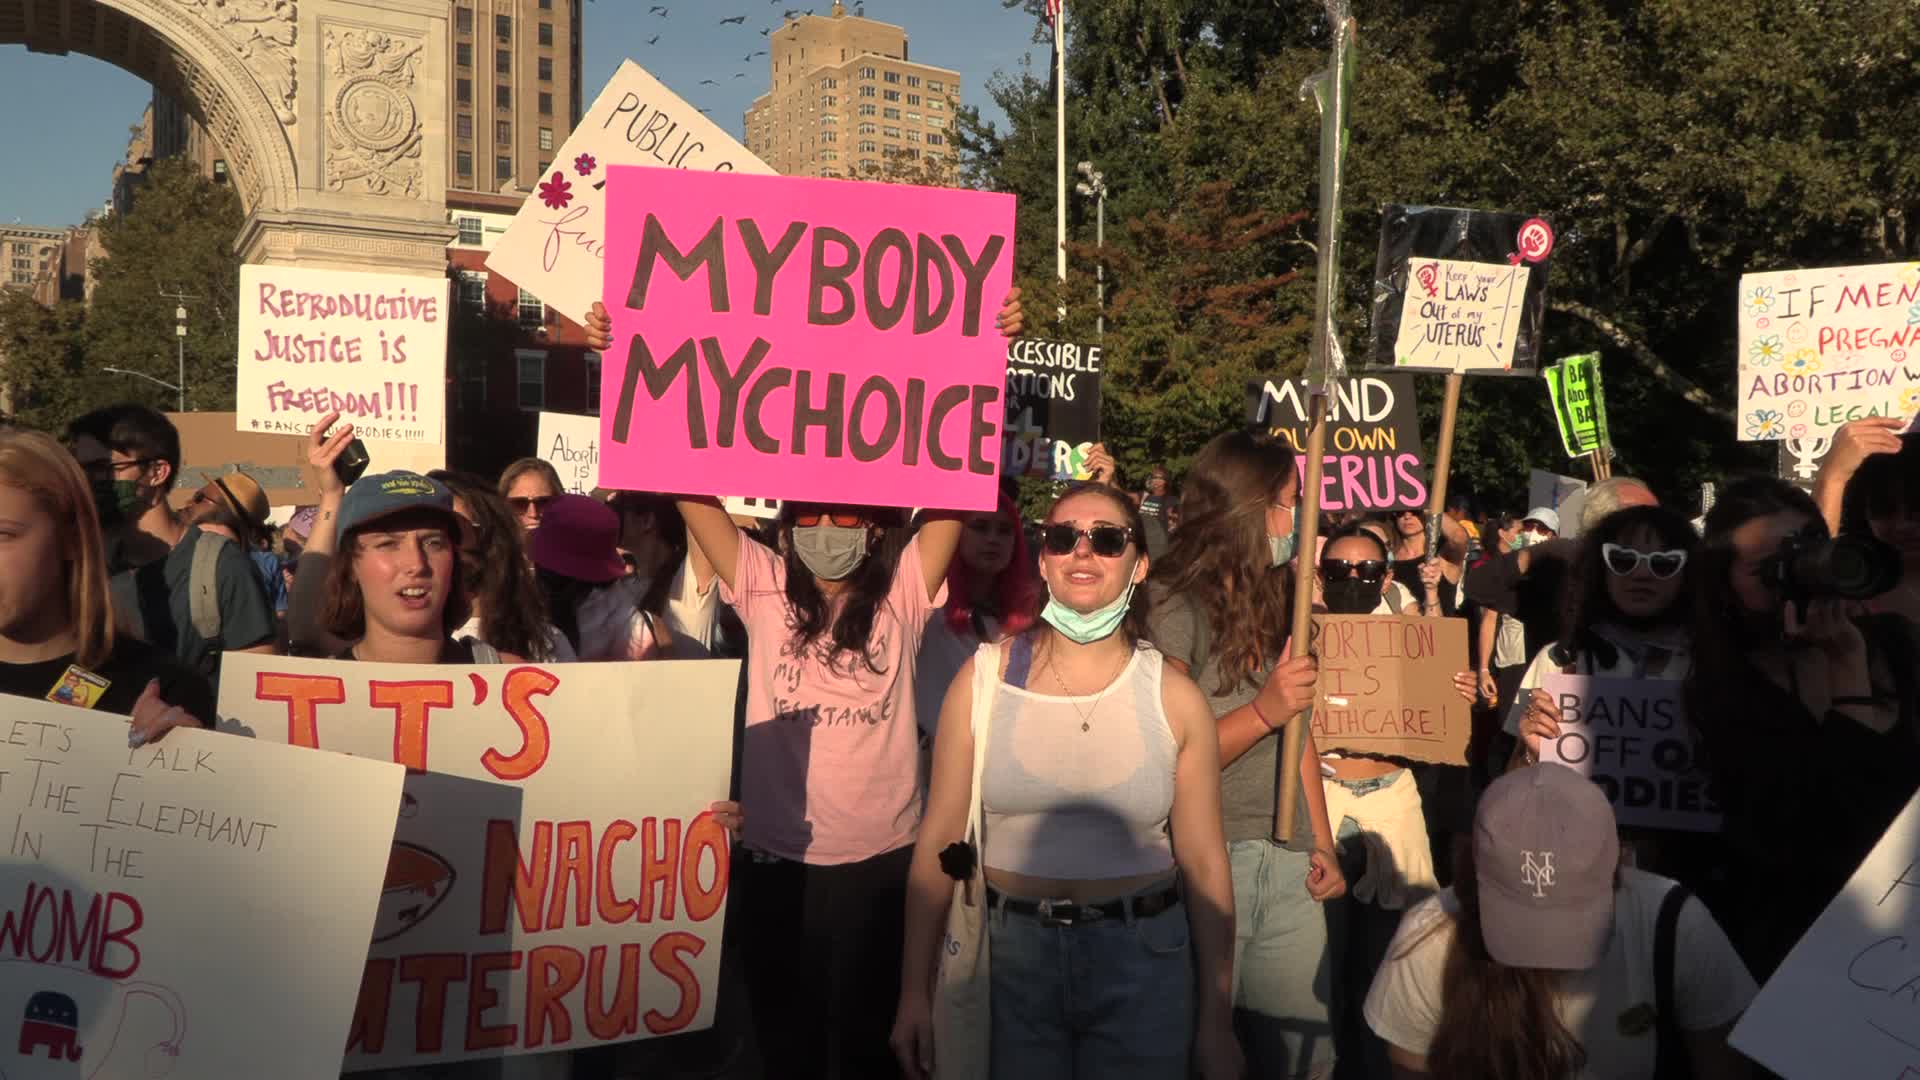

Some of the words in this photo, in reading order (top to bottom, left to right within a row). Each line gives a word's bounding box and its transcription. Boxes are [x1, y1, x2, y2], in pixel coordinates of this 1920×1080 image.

[1445, 282, 1488, 302] LAWS
[1777, 285, 1826, 319] IF
[1427, 322, 1486, 347] UTERUS
[266, 380, 418, 422] FREEDOM!!!
[1256, 378, 1395, 422] MND
[1748, 367, 1897, 400] ABORTION
[1334, 427, 1396, 452] OWN
[1326, 664, 1381, 696] IS
[1559, 693, 1674, 730] BANS
[1556, 732, 1640, 767] OFF
[24, 758, 85, 814] THE
[106, 772, 278, 852] ELEPHANT
[11, 813, 43, 860] IN
[80, 823, 145, 879] THE
[479, 810, 731, 935] NACHO
